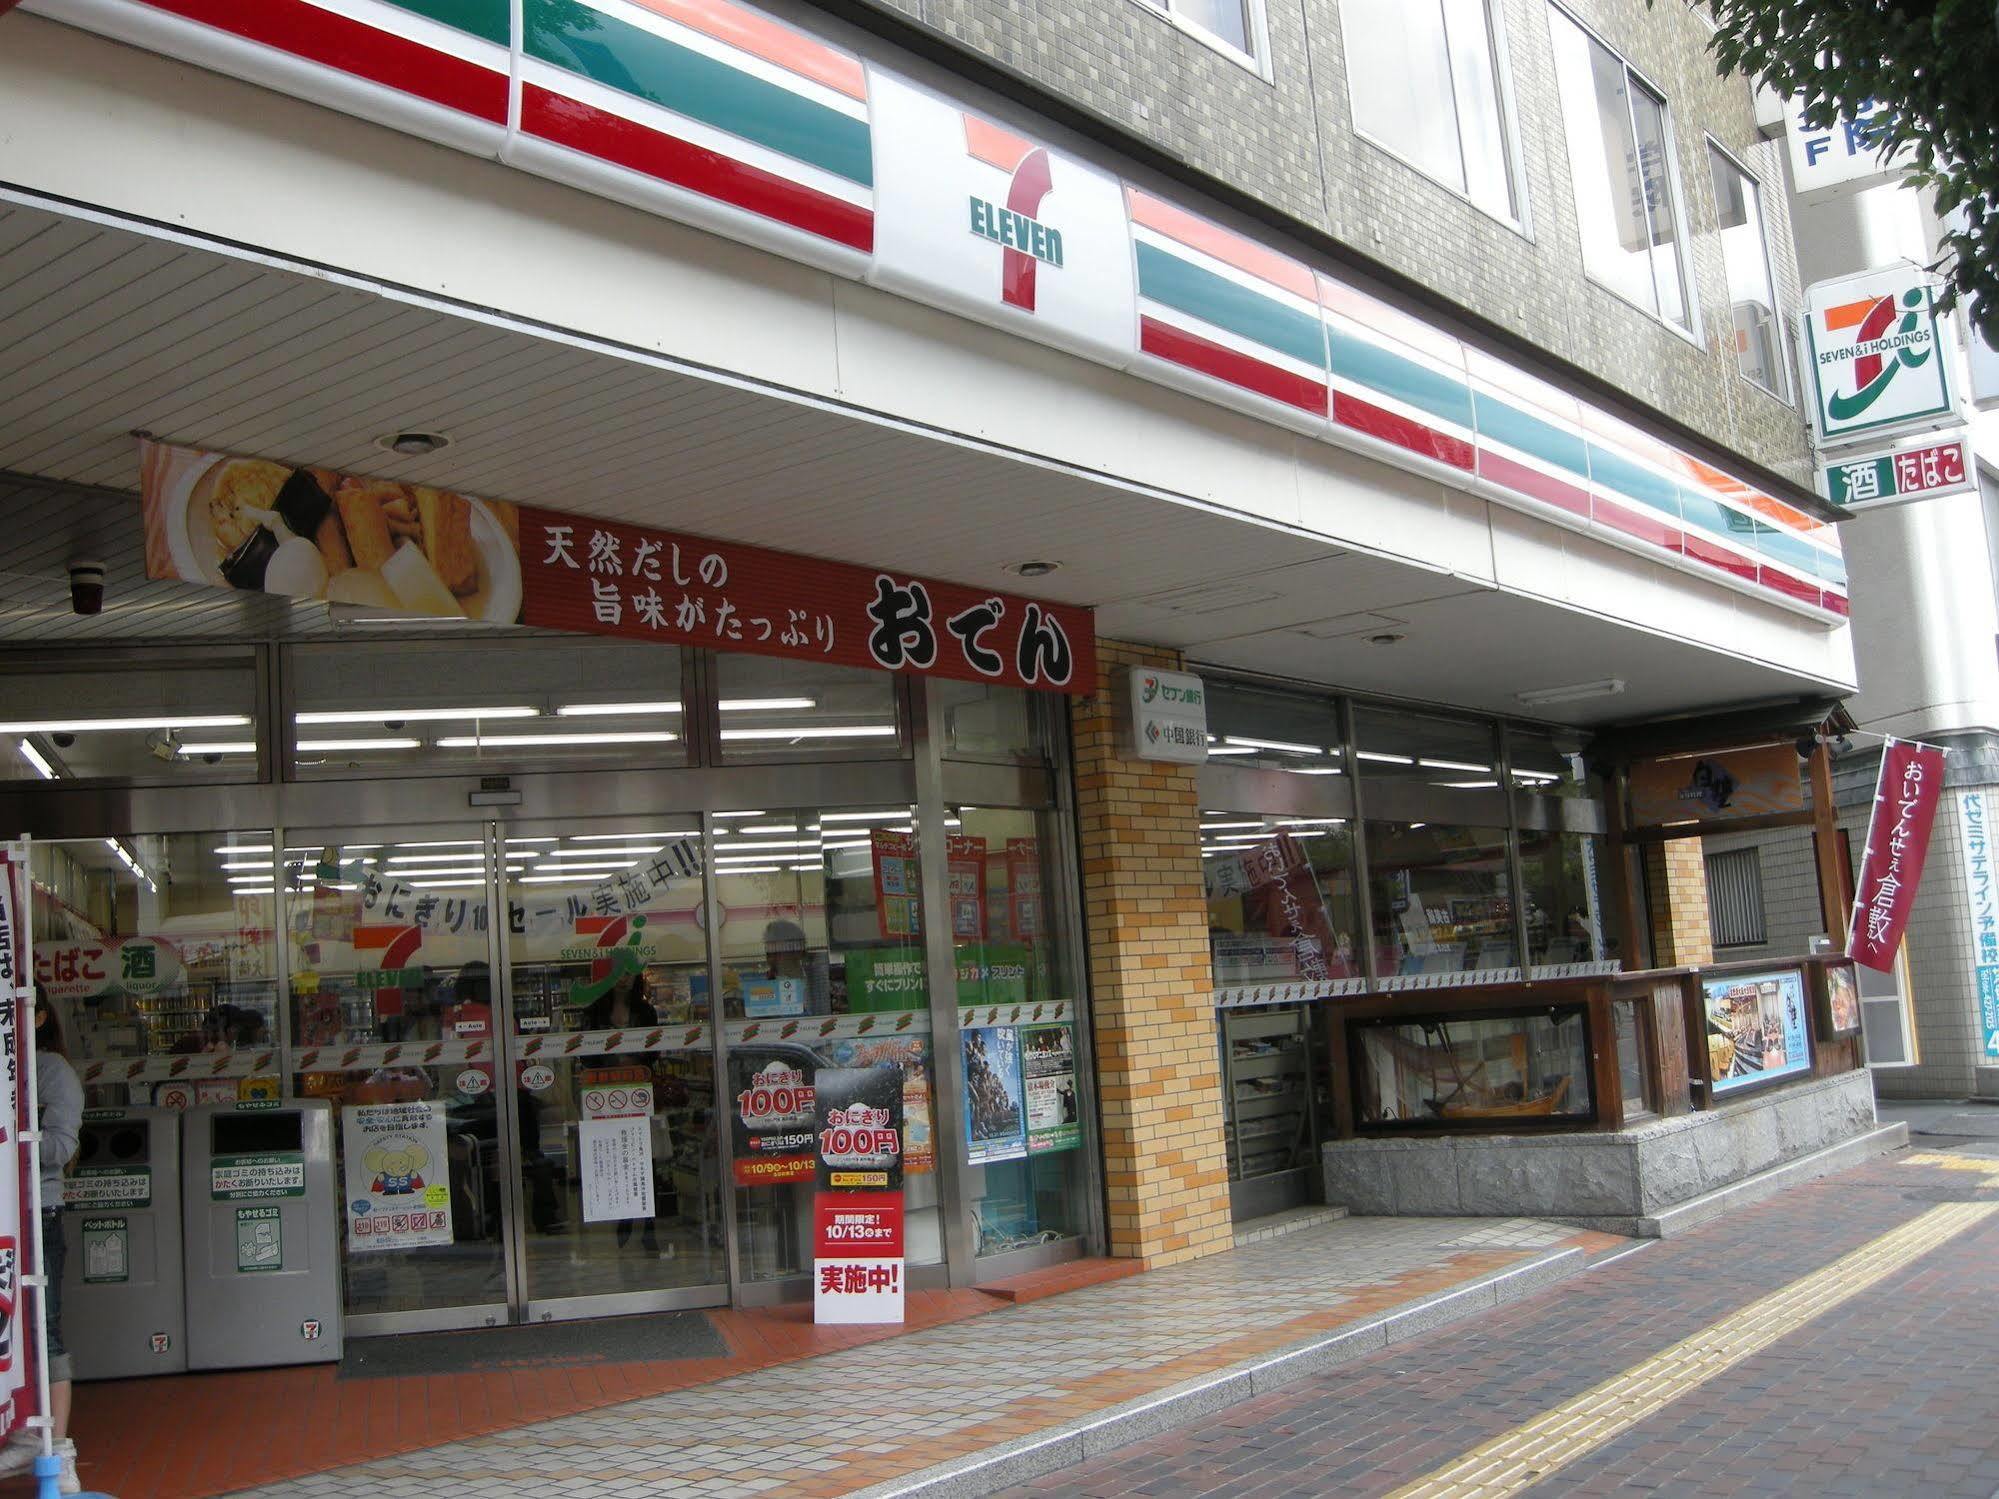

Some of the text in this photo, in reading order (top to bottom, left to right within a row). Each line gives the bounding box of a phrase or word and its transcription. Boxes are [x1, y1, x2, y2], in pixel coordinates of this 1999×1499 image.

[969, 195, 1064, 267] ELEVEN
[1869, 328, 1931, 355] HOLDINGS
[1840, 448, 1963, 501] 酒 たばこ
[542, 525, 728, 589] 天然だしの
[591, 577, 836, 653] 旨味がたっぷり
[866, 573, 1073, 686] おでん
[1161, 684, 1202, 705] セブン銀行
[1163, 725, 1206, 747] 中国銀行
[34, 949, 105, 981] たばこ
[121, 945, 156, 980] 酒
[752, 1070, 803, 1086] おにぎり
[737, 1086, 815, 1118] 100円
[828, 1109, 890, 1126] おにぎり
[784, 1133, 814, 1146] 150円
[819, 1128, 900, 1156] 100円
[214, 1166, 301, 1179] 家庭ゴミの持ち込みは
[84, 1219, 126, 1229] ペットボトル
[237, 1208, 280, 1218] もやせるゴミ
[820, 1263, 899, 1295] 実施中!
